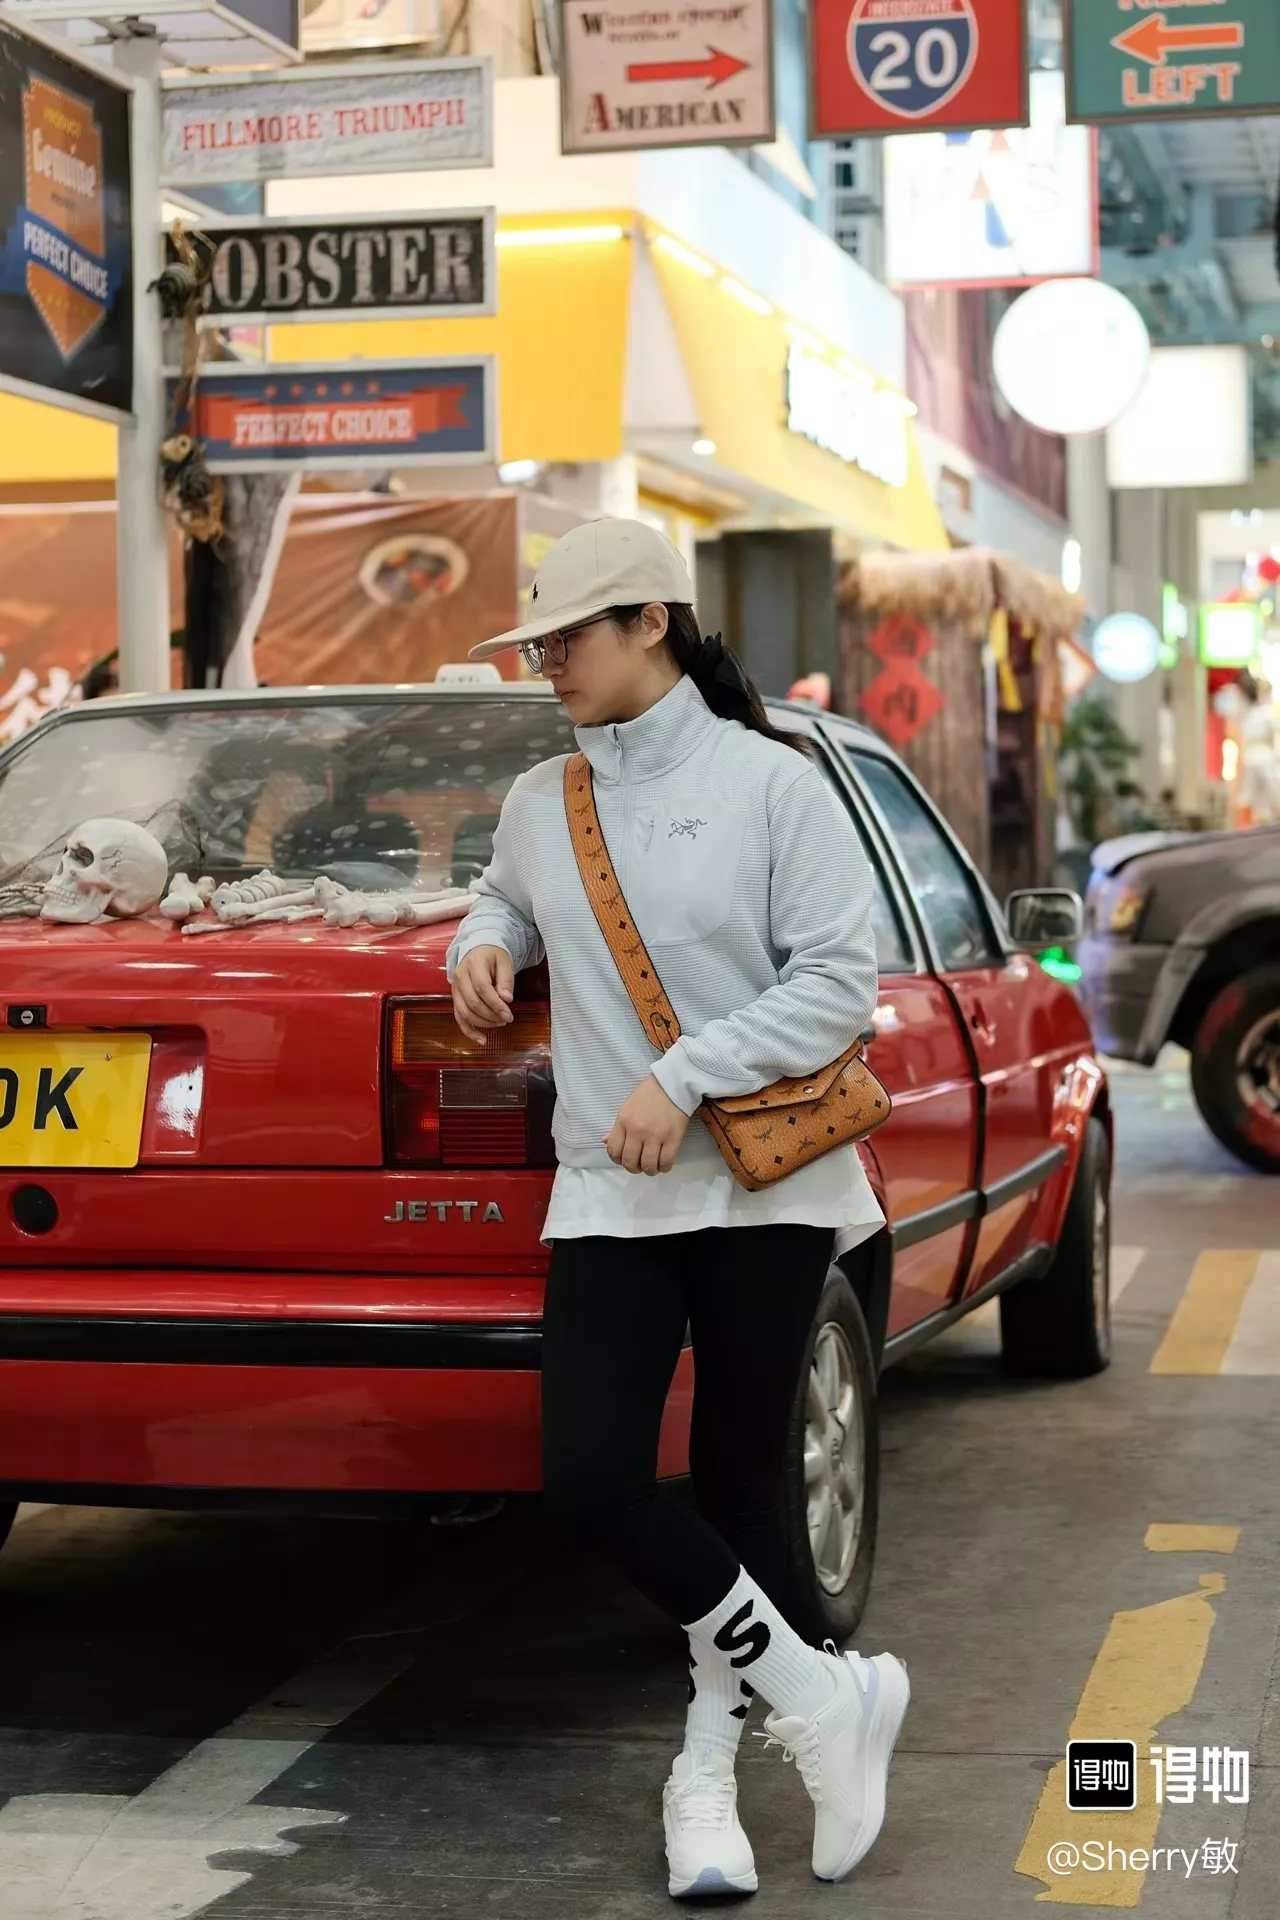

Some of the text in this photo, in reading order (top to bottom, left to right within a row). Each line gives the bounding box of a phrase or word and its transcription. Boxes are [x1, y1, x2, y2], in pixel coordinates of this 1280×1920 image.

[869, 28, 958, 90] 20
[1121, 61, 1241, 106] LEFT
[182, 98, 465, 151] FILLMORE TRIUMPH
[584, 93, 745, 133] AMERICAN
[23, 220, 108, 299] PERFECT CHOICE
[203, 226, 473, 310] OBSTER
[234, 407, 413, 443] PERFECT CHOICE
[384, 1200, 505, 1222] JETTA
